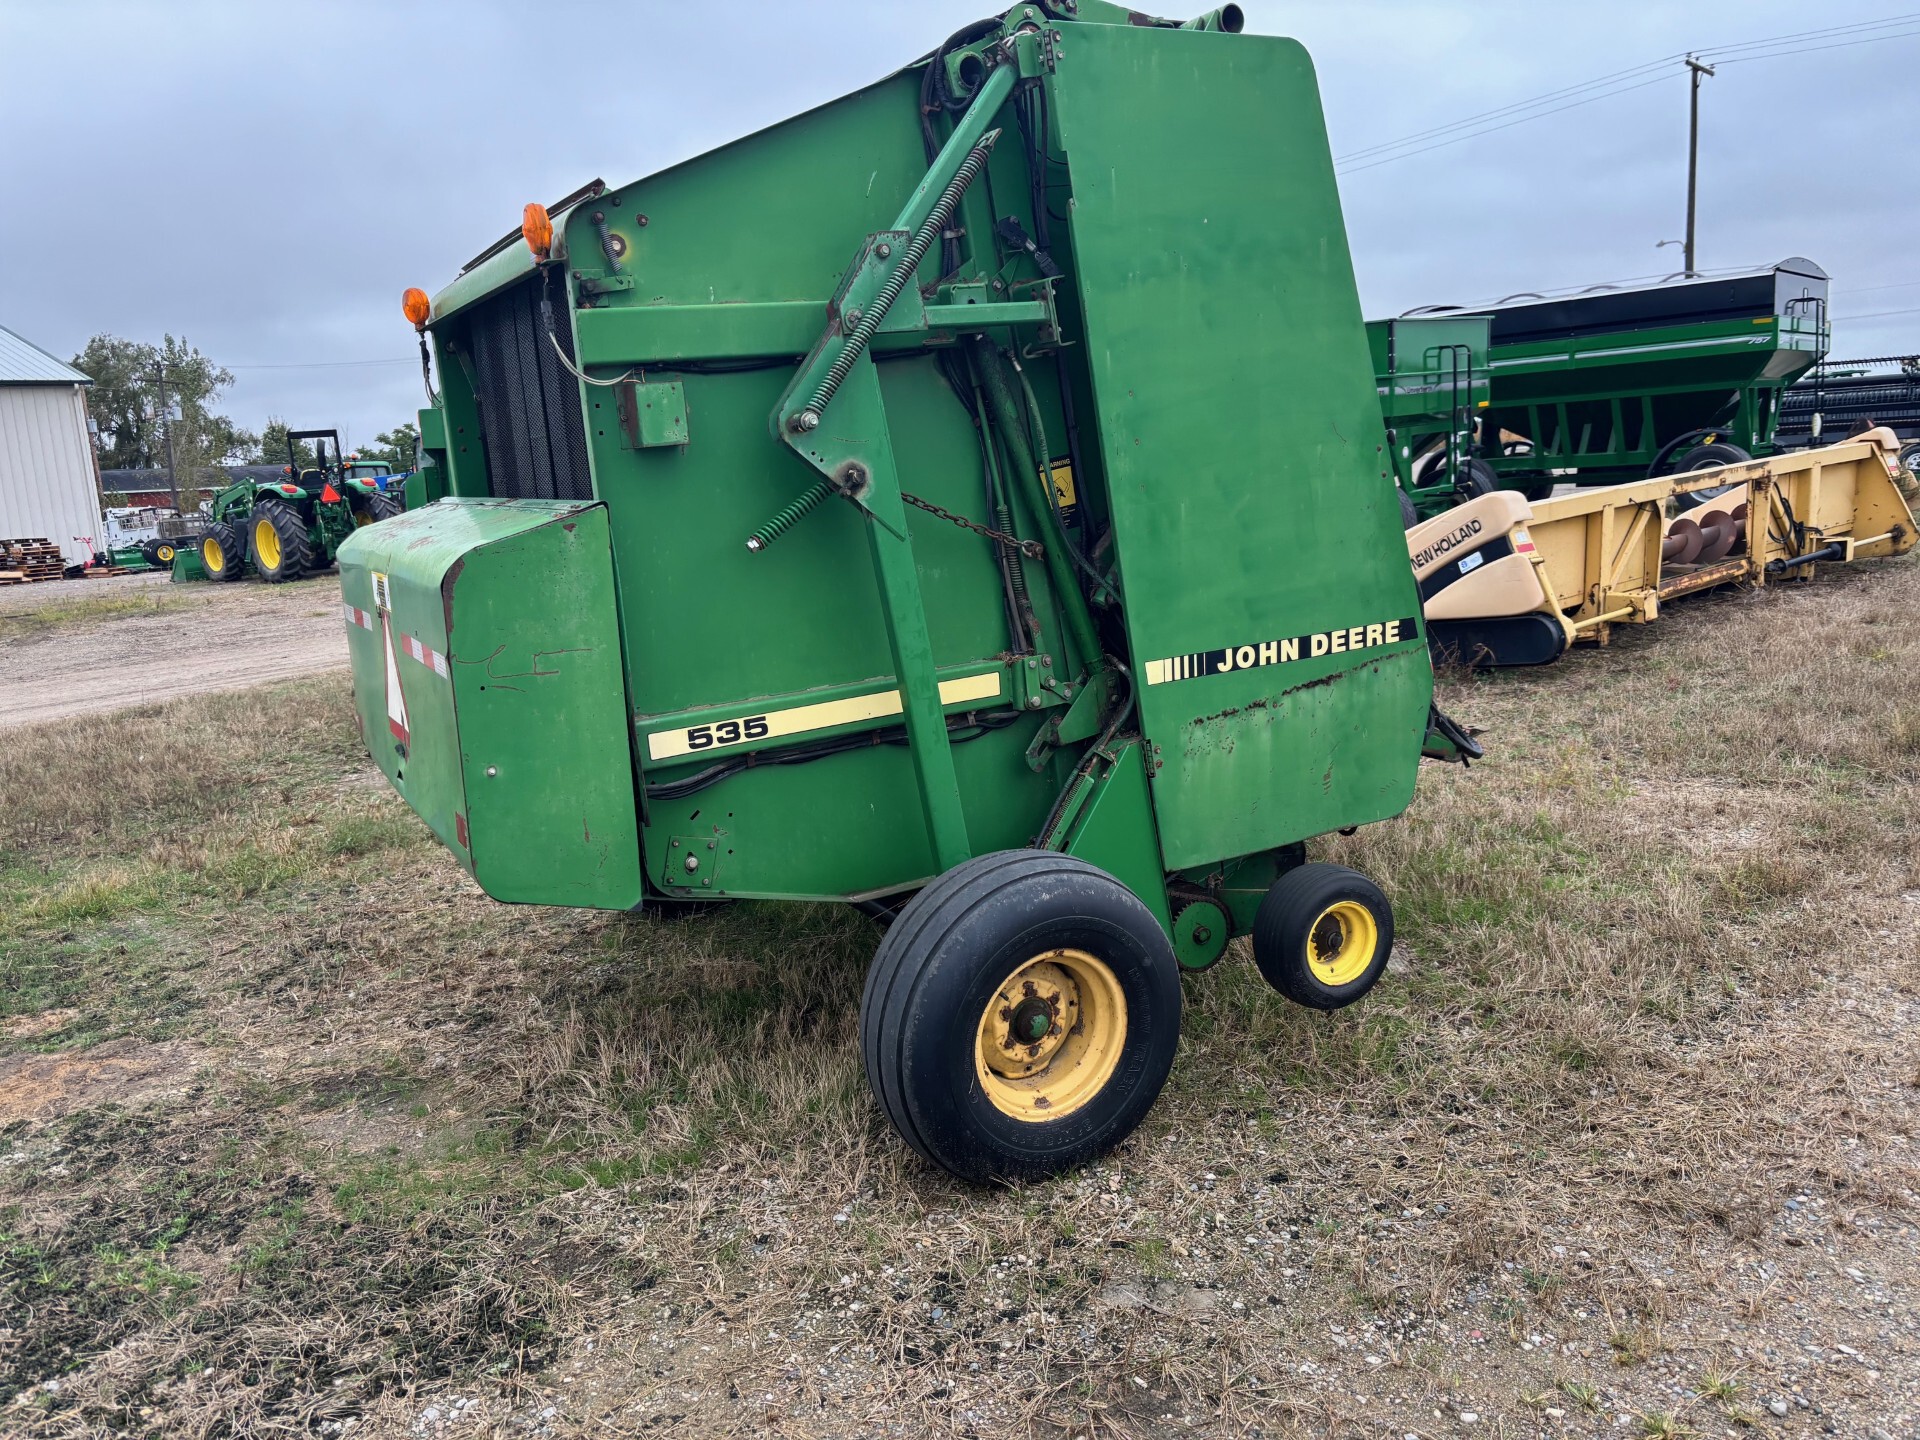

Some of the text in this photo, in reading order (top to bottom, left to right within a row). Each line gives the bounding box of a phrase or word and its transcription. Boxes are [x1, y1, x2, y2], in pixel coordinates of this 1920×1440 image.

[1049, 458, 1071, 468] ARNING
[1410, 552, 1433, 571] NEW
[1434, 519, 1482, 561] HOLLAND
[1217, 620, 1400, 673] JOHN DEERE
[687, 716, 769, 750] 535
